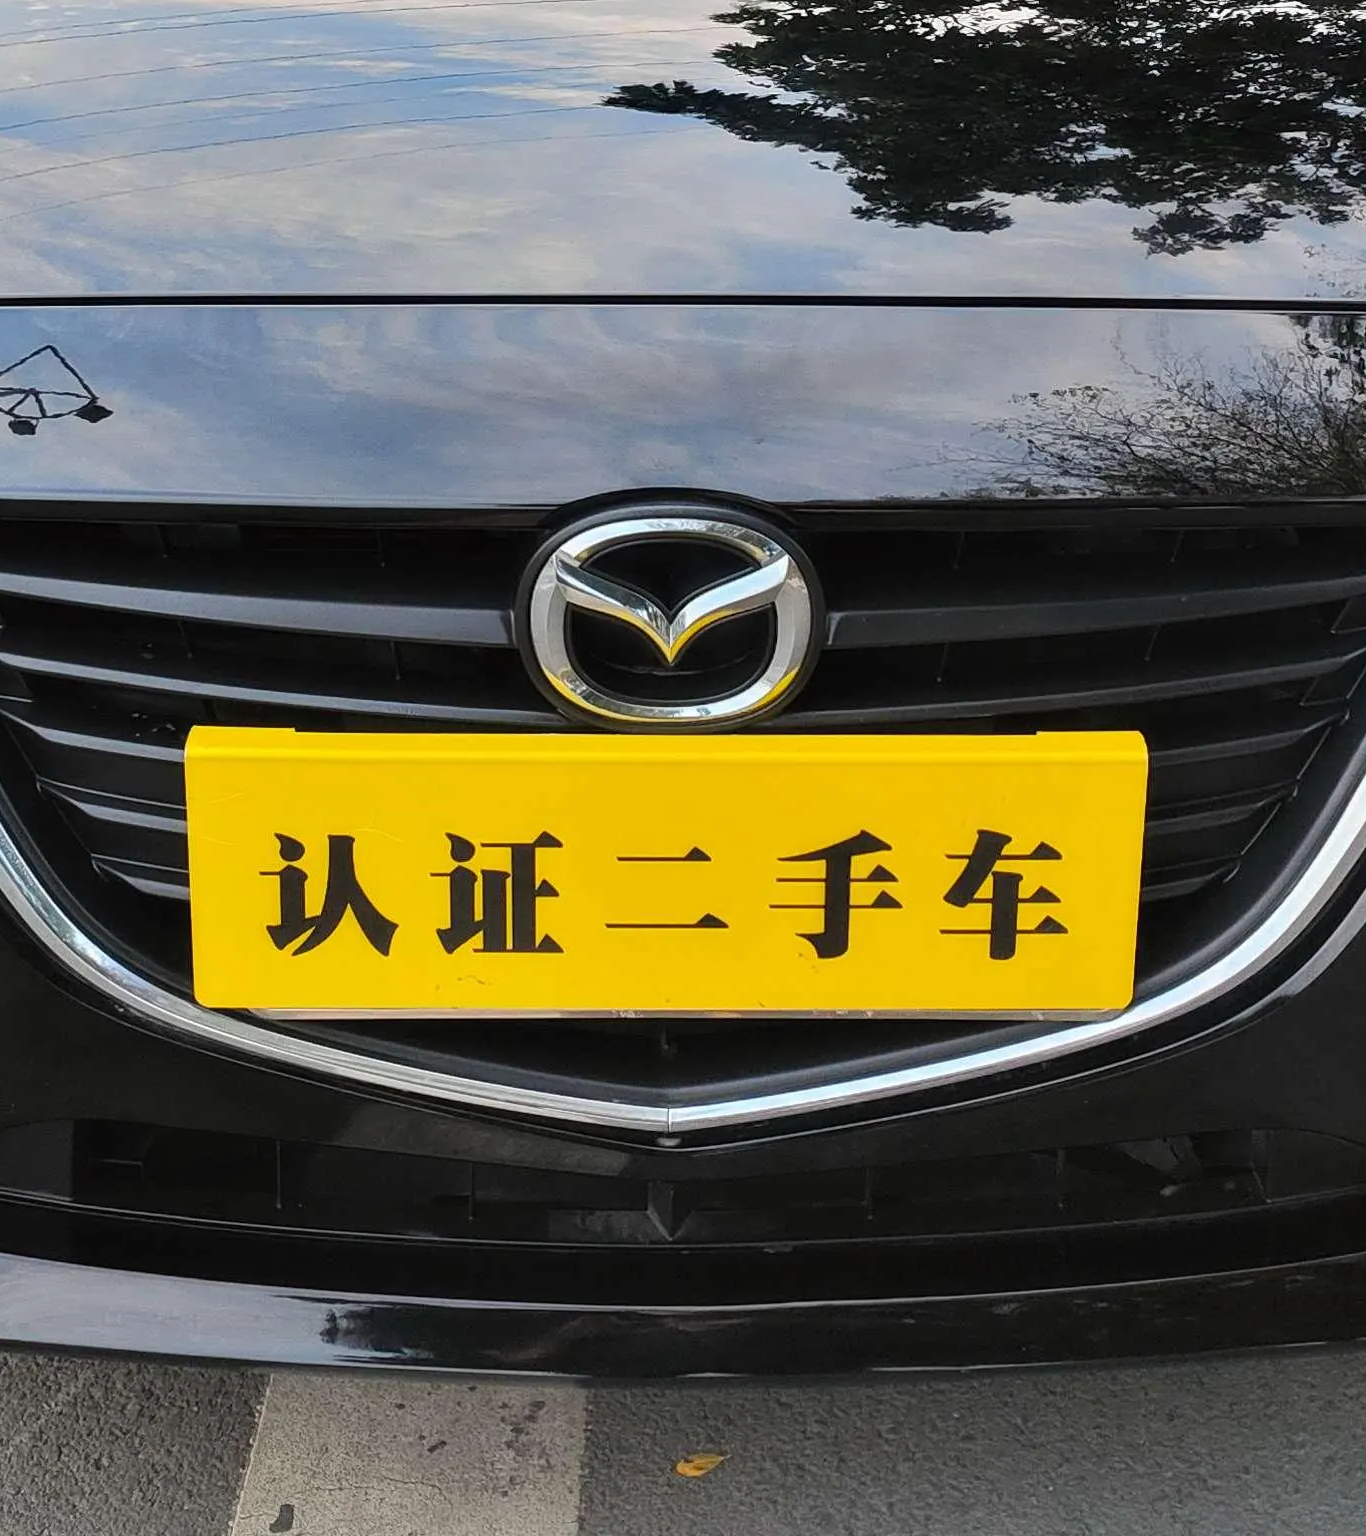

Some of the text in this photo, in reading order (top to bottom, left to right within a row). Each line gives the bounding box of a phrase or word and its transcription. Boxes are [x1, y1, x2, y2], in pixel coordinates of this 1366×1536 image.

[259, 829, 1069, 961] 认证二手车
